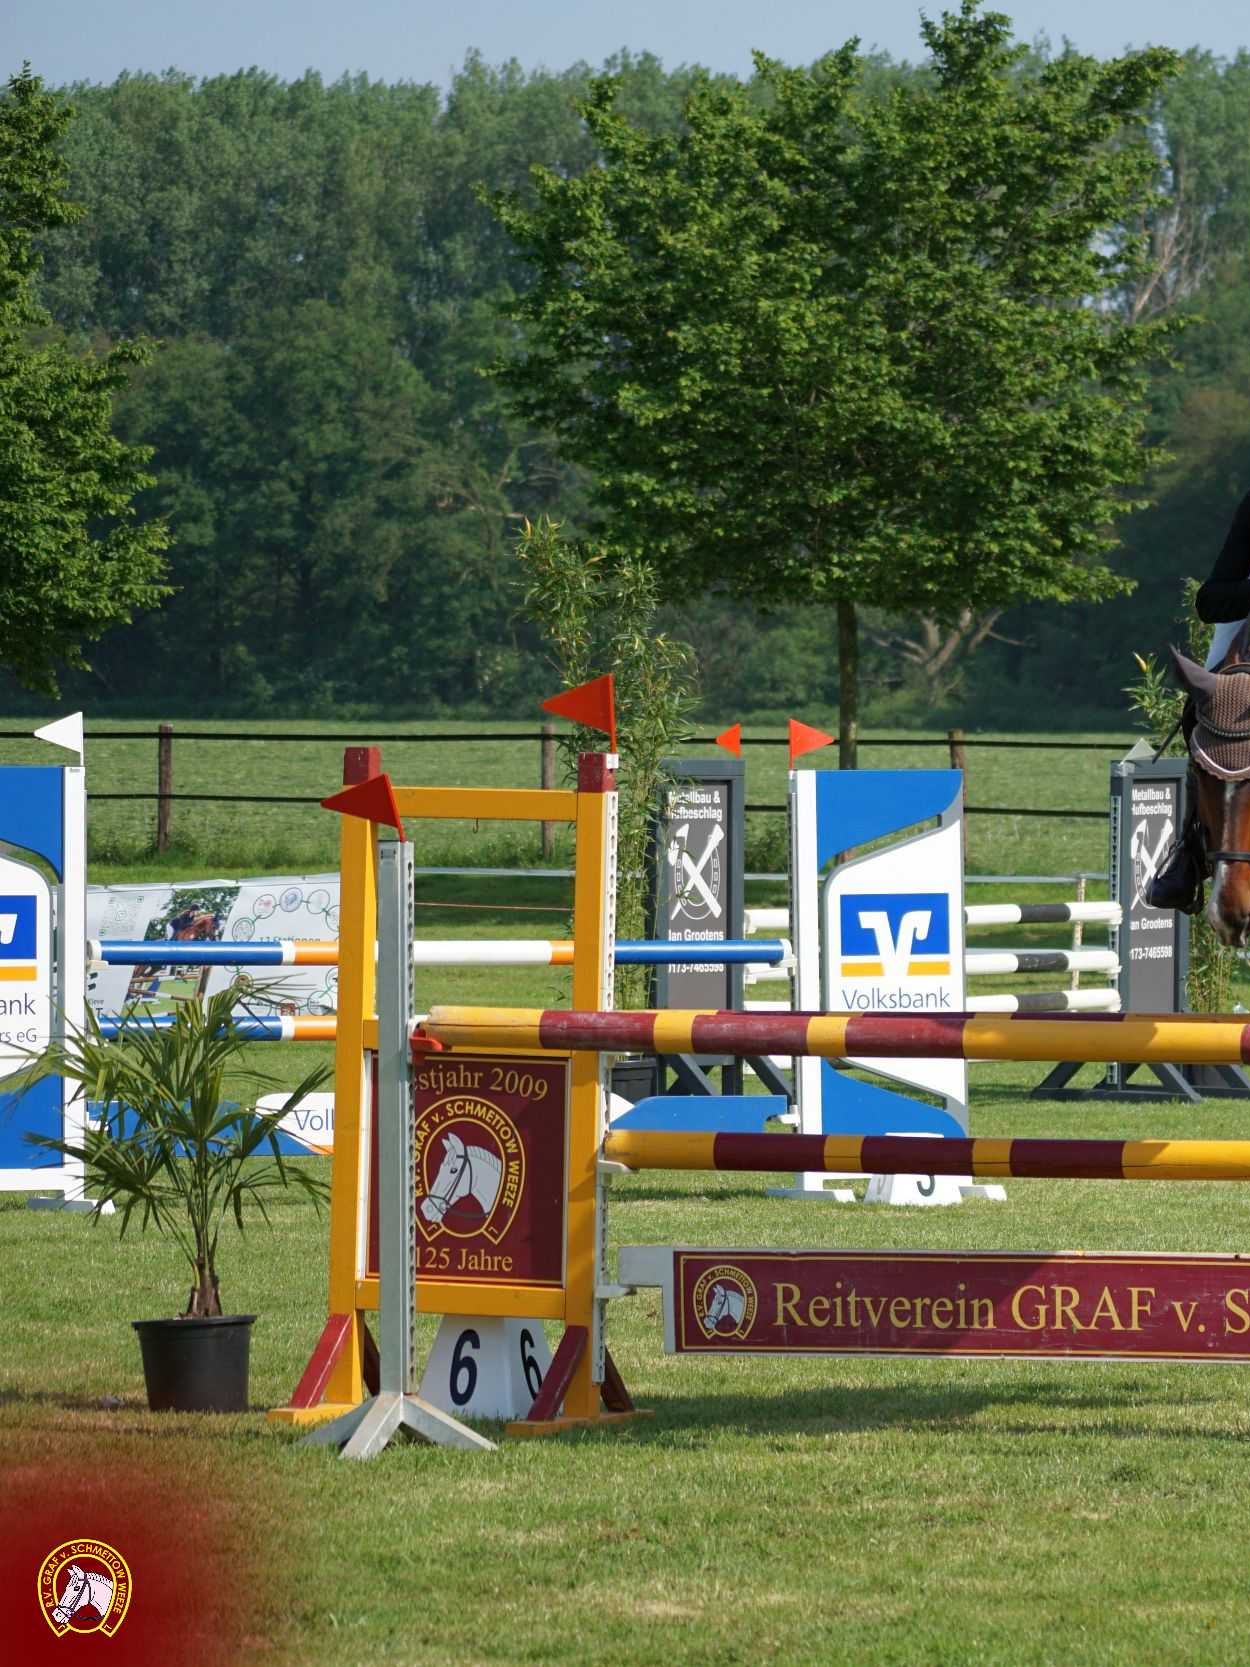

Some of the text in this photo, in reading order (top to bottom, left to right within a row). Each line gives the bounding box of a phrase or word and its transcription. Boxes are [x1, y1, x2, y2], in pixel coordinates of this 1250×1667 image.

[713, 790, 721, 804] &
[1131, 787, 1164, 801] Metallbau
[842, 986, 951, 1010] Volksbank
[16, 1027, 37, 1043] eG
[489, 1067, 548, 1101] 2009
[446, 1101, 519, 1154] SCHMETTOW
[502, 1160, 521, 1208] WEEZE
[457, 1248, 513, 1272] Jahre
[772, 1281, 997, 1330] Reitverein
[1011, 1283, 1156, 1332] GRAF
[1171, 1300, 1206, 1333] v.
[449, 1328, 481, 1406] 6
